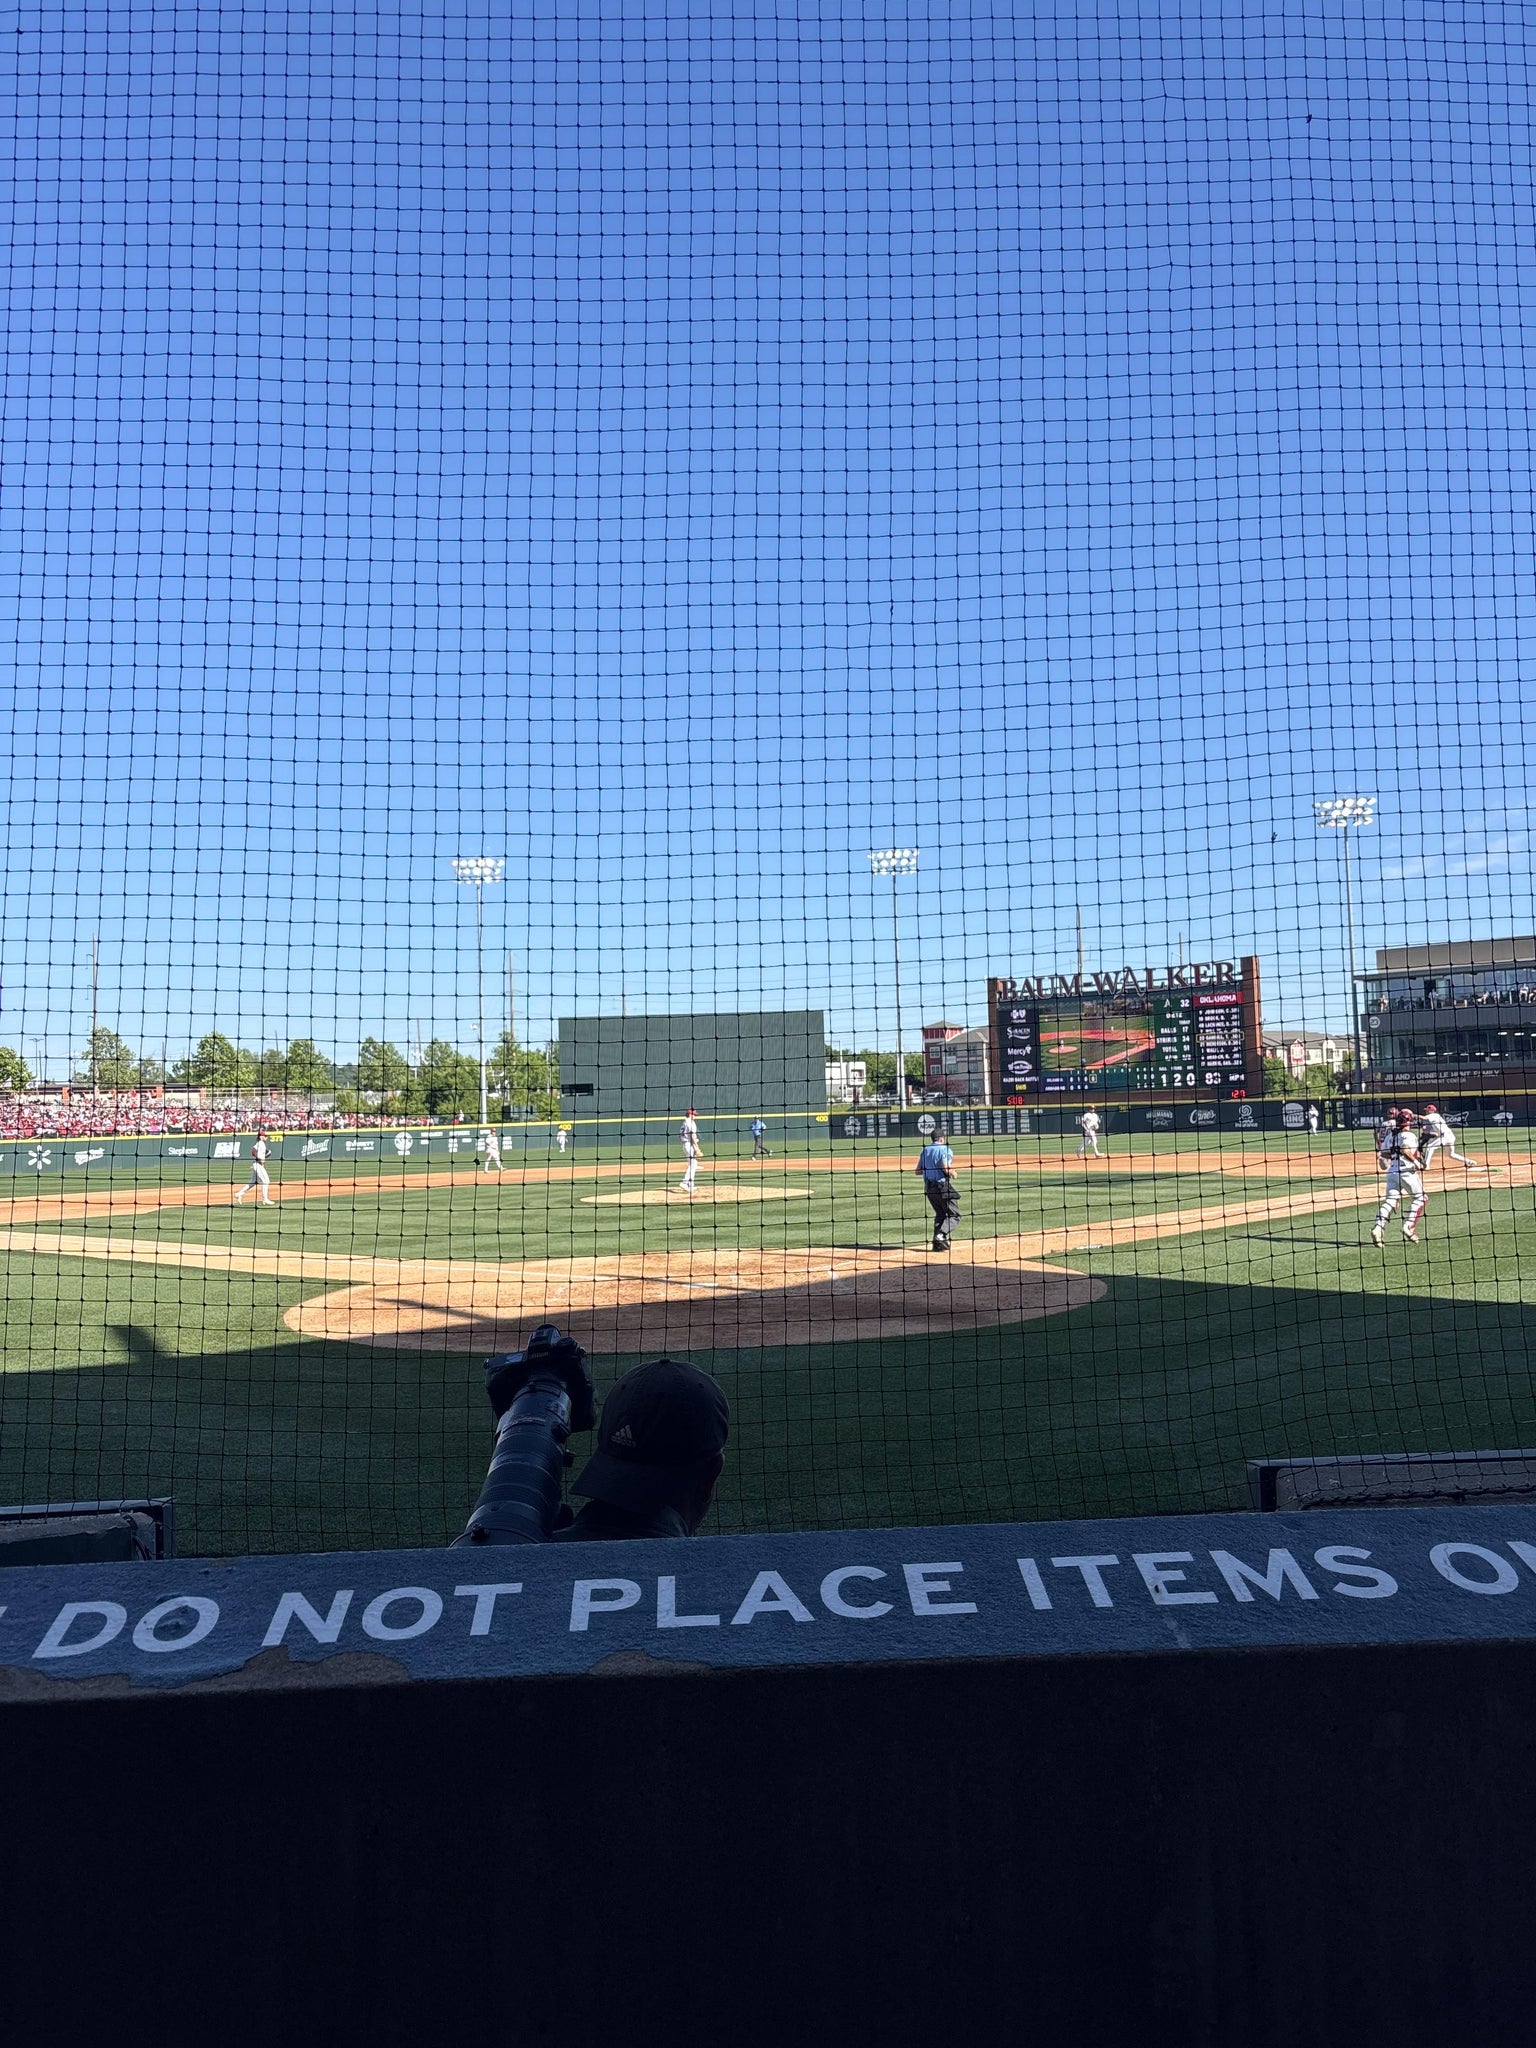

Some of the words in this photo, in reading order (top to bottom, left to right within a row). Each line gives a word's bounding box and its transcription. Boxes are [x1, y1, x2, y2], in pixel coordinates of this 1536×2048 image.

[999, 962, 1237, 1001] BAUM-WALKER
[1180, 999, 1190, 1007] 32
[1008, 1047, 1026, 1057] Mercy
[1161, 1074, 1167, 1087] 1
[1173, 1073, 1182, 1086] 2
[1186, 1072, 1195, 1086] 0
[558, 1123, 572, 1131] 400
[168, 1145, 198, 1157] Stephens
[32, 1596, 220, 1659] DO
[262, 1582, 523, 1647] NOT
[569, 1561, 978, 1632] PLACE
[1016, 1545, 1399, 1610] ITEMS
